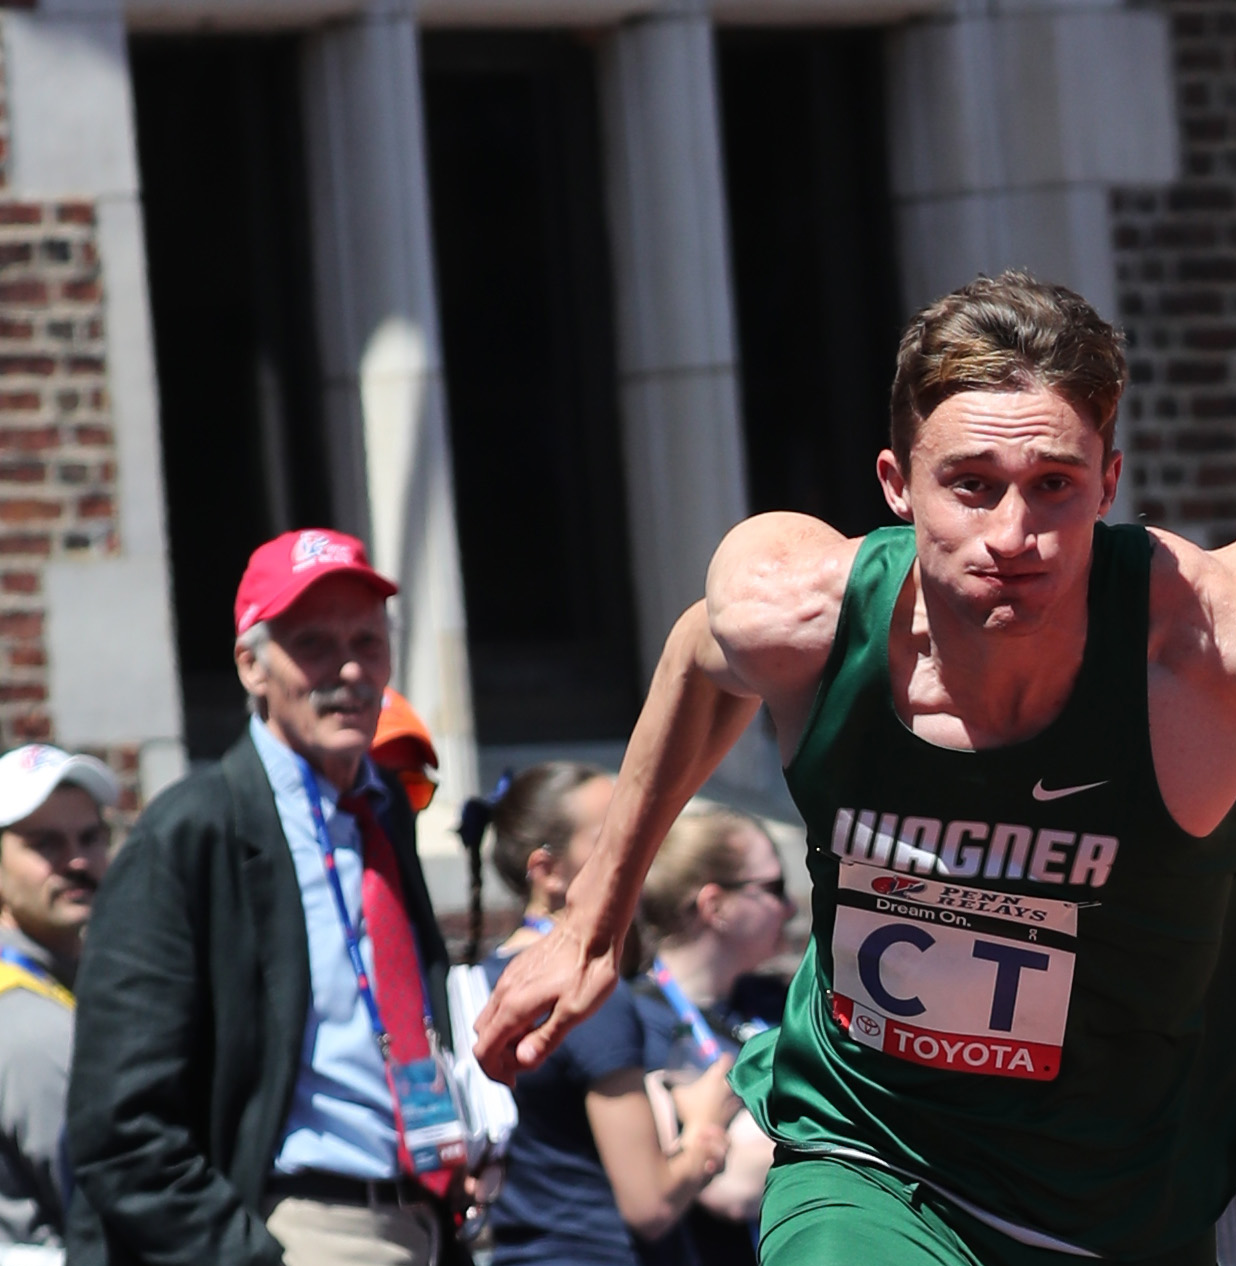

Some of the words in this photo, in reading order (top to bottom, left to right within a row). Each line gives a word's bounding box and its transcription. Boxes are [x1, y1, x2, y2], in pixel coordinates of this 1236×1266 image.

[831, 807, 1120, 888] WAGNER
[937, 897, 1048, 922] RELAYS
[939, 886, 1024, 905] PENN
[876, 898, 935, 920] Dream
[939, 911, 972, 928] On.
[892, 1027, 1035, 1072] TOYOTA
